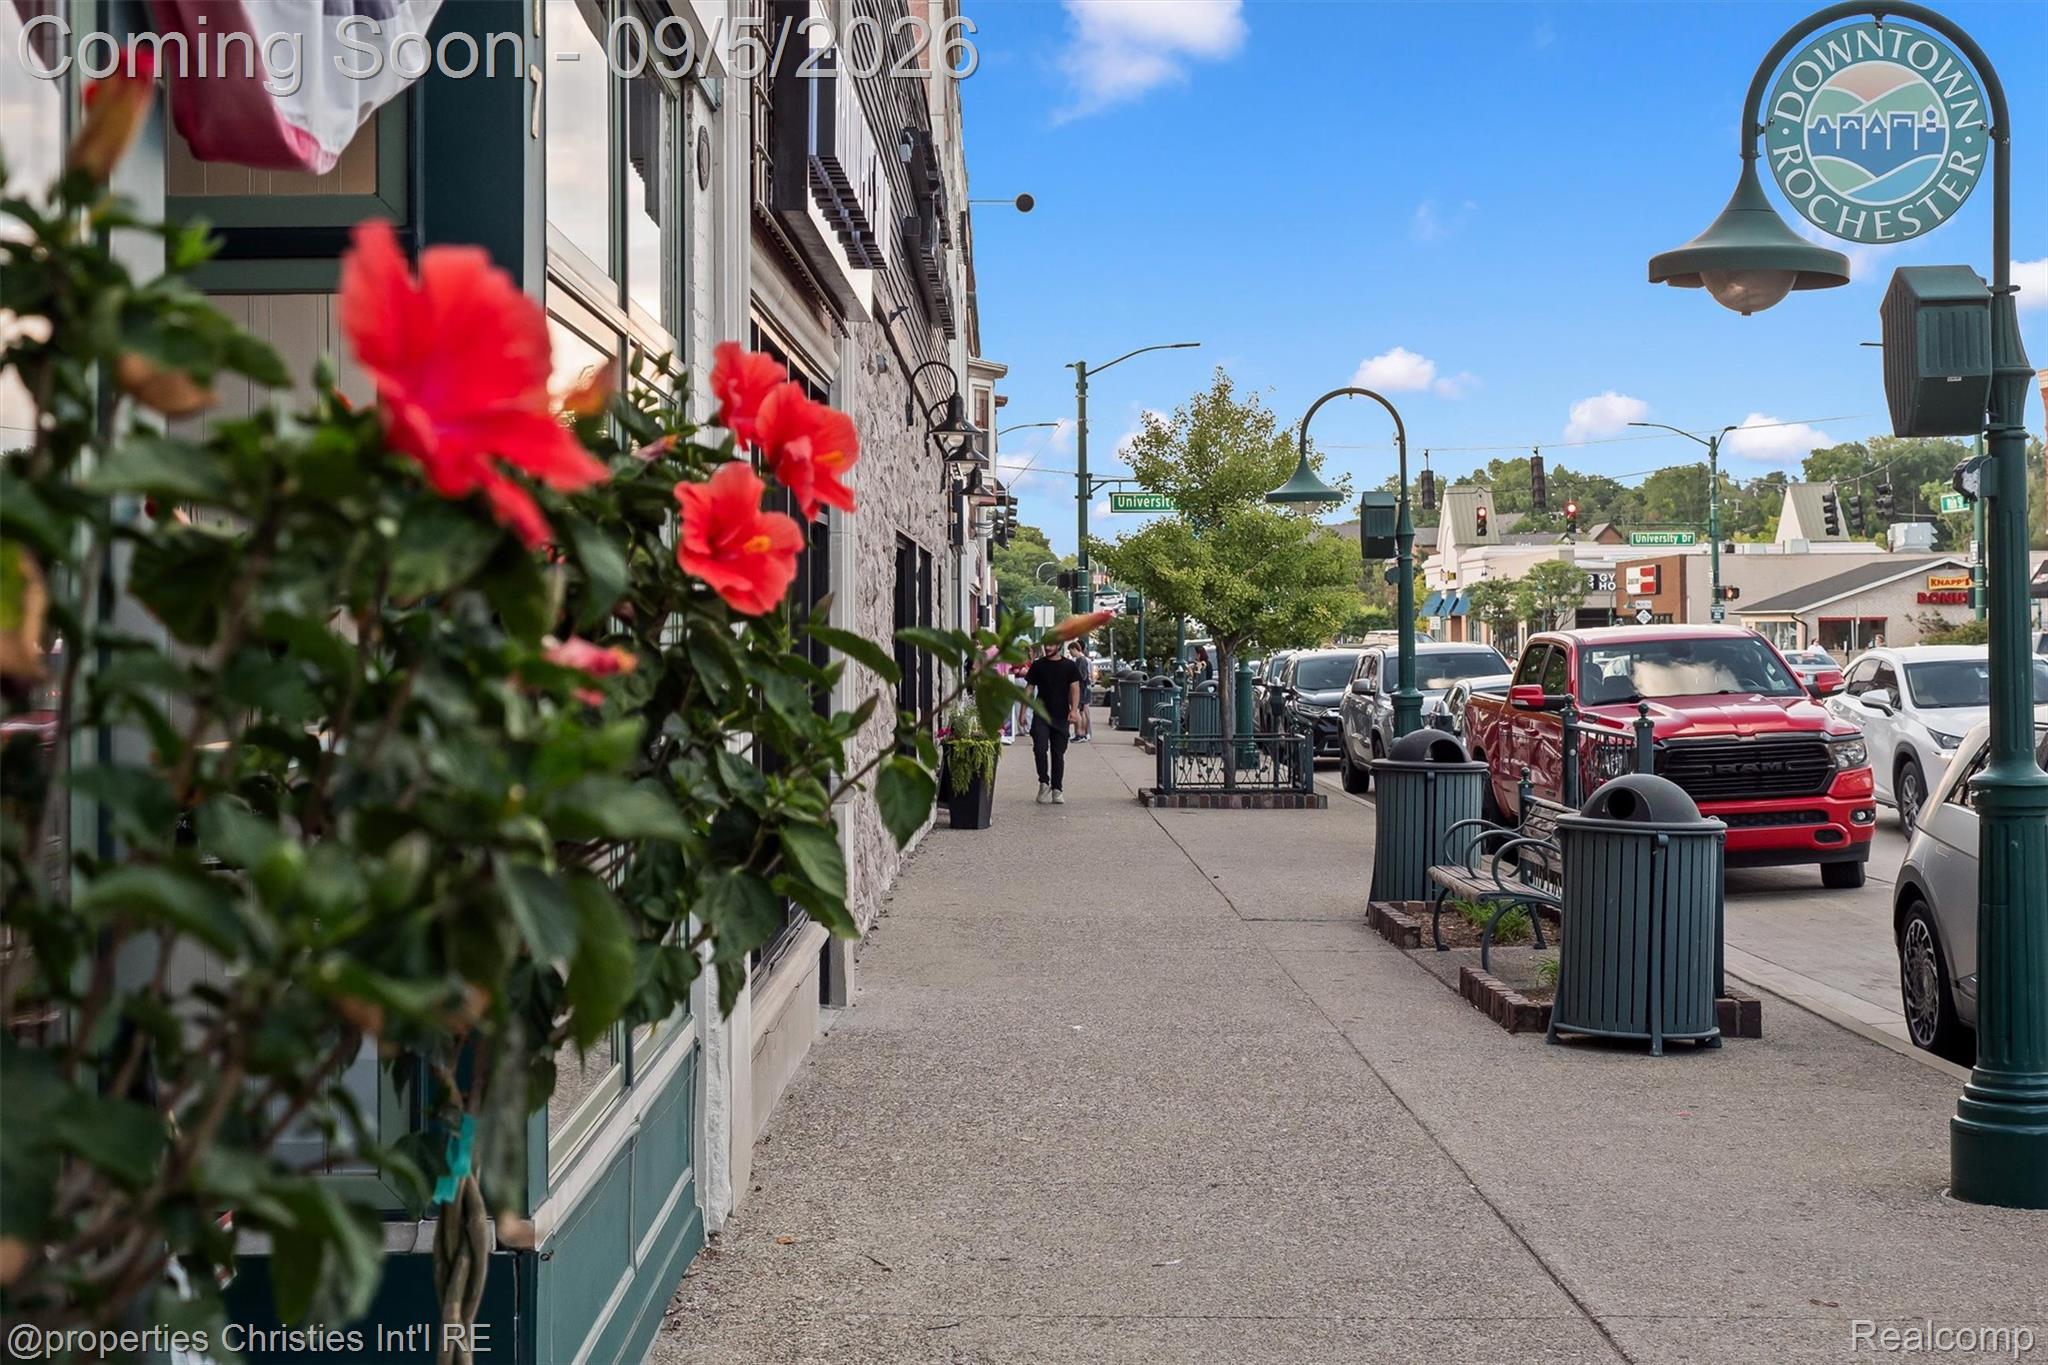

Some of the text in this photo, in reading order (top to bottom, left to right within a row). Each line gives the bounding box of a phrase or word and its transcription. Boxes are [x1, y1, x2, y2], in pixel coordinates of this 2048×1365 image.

[1773, 28, 1985, 131] DOWNTOWN
[1772, 143, 1982, 241] ROCHESTER
[1635, 534, 1692, 544] University Dr
[1714, 761, 1784, 775] RAM
